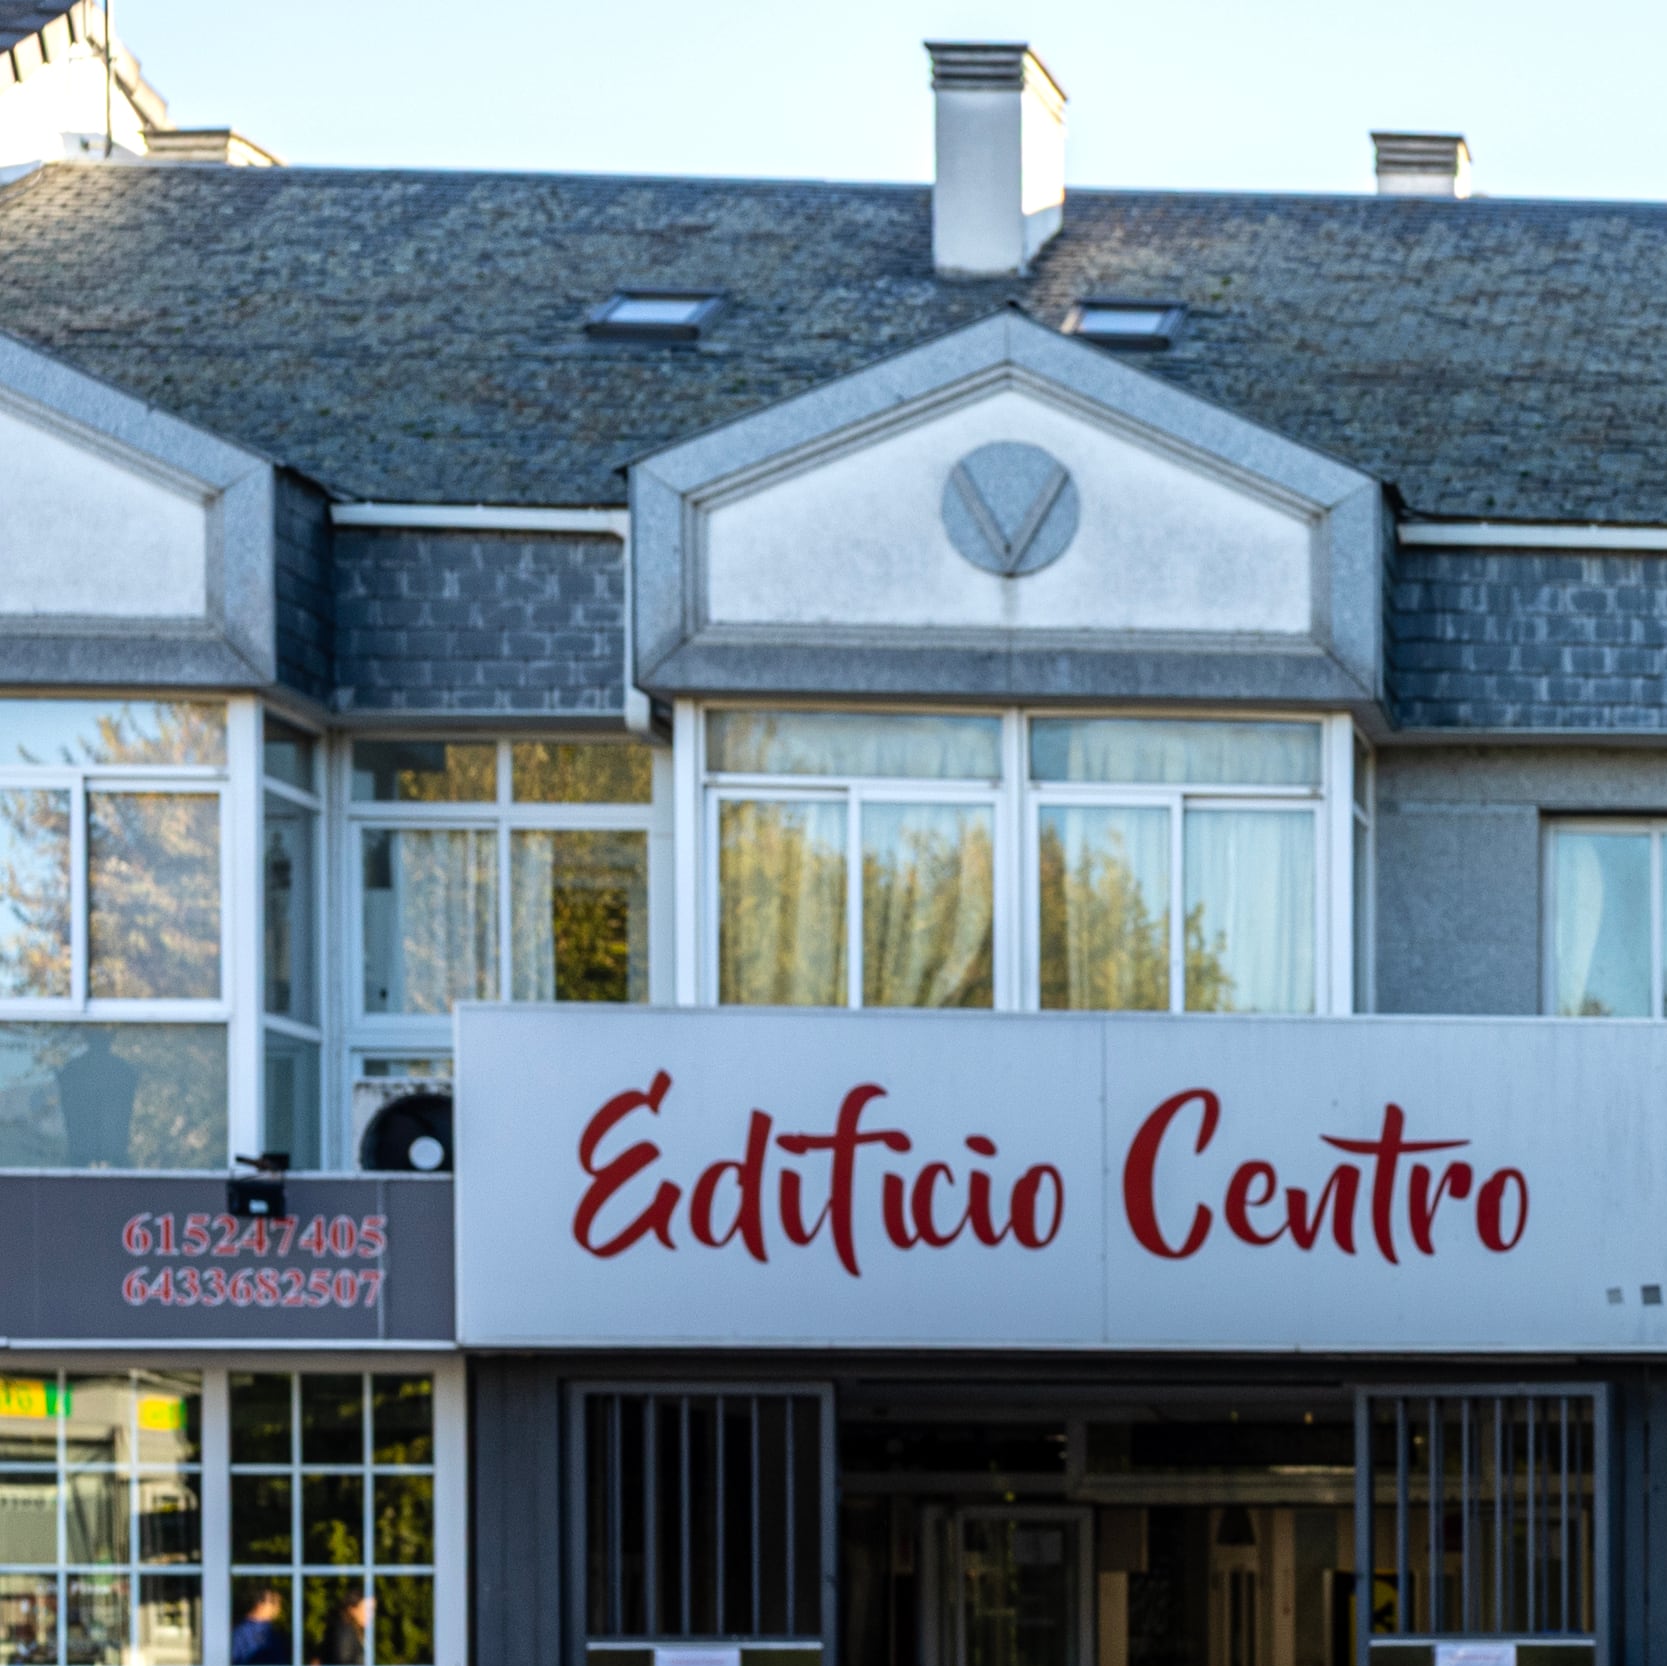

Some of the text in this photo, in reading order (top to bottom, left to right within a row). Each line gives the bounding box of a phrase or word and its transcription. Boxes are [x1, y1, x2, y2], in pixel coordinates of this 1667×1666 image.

[571, 1069, 1529, 1278] Edificio Centro
[121, 1212, 388, 1258] 615247405
[121, 1266, 386, 1308] 6433682507
